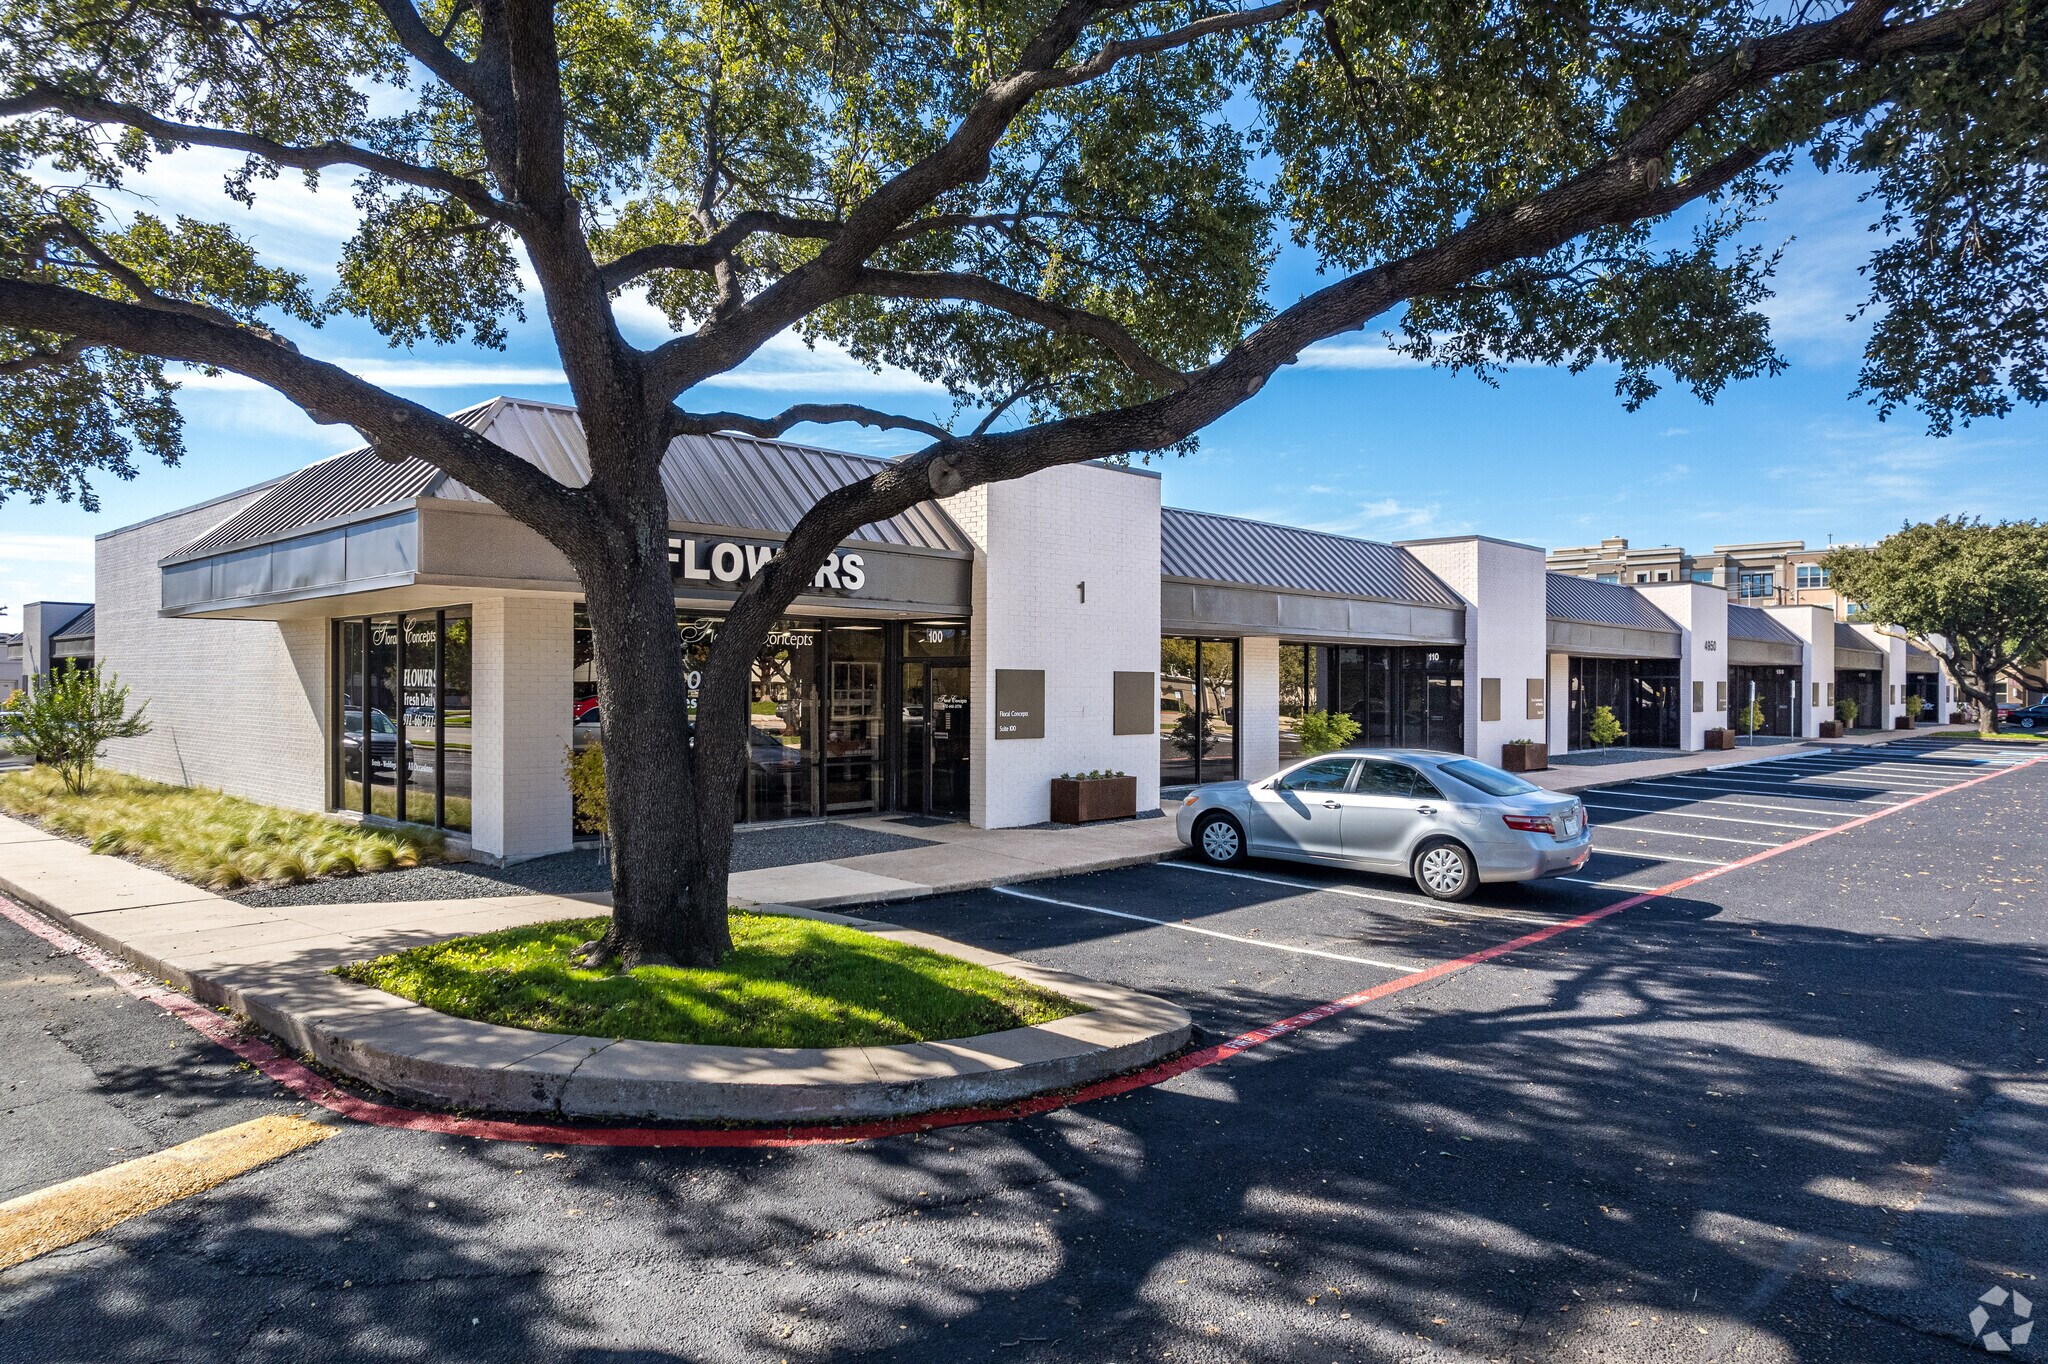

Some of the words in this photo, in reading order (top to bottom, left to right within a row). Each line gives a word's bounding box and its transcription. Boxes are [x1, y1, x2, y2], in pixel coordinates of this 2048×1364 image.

[669, 538, 865, 590] LOWRS
[1076, 581, 1085, 604] 1
[373, 620, 398, 646] Flora
[403, 617, 436, 646] Concepts
[928, 630, 943, 643] 100
[1428, 652, 1440, 661] 110
[403, 668, 436, 687] FLOWERS
[403, 692, 420, 706] Fresh
[420, 693, 436, 711] Daily
[403, 713, 436, 728] 972-661-377
